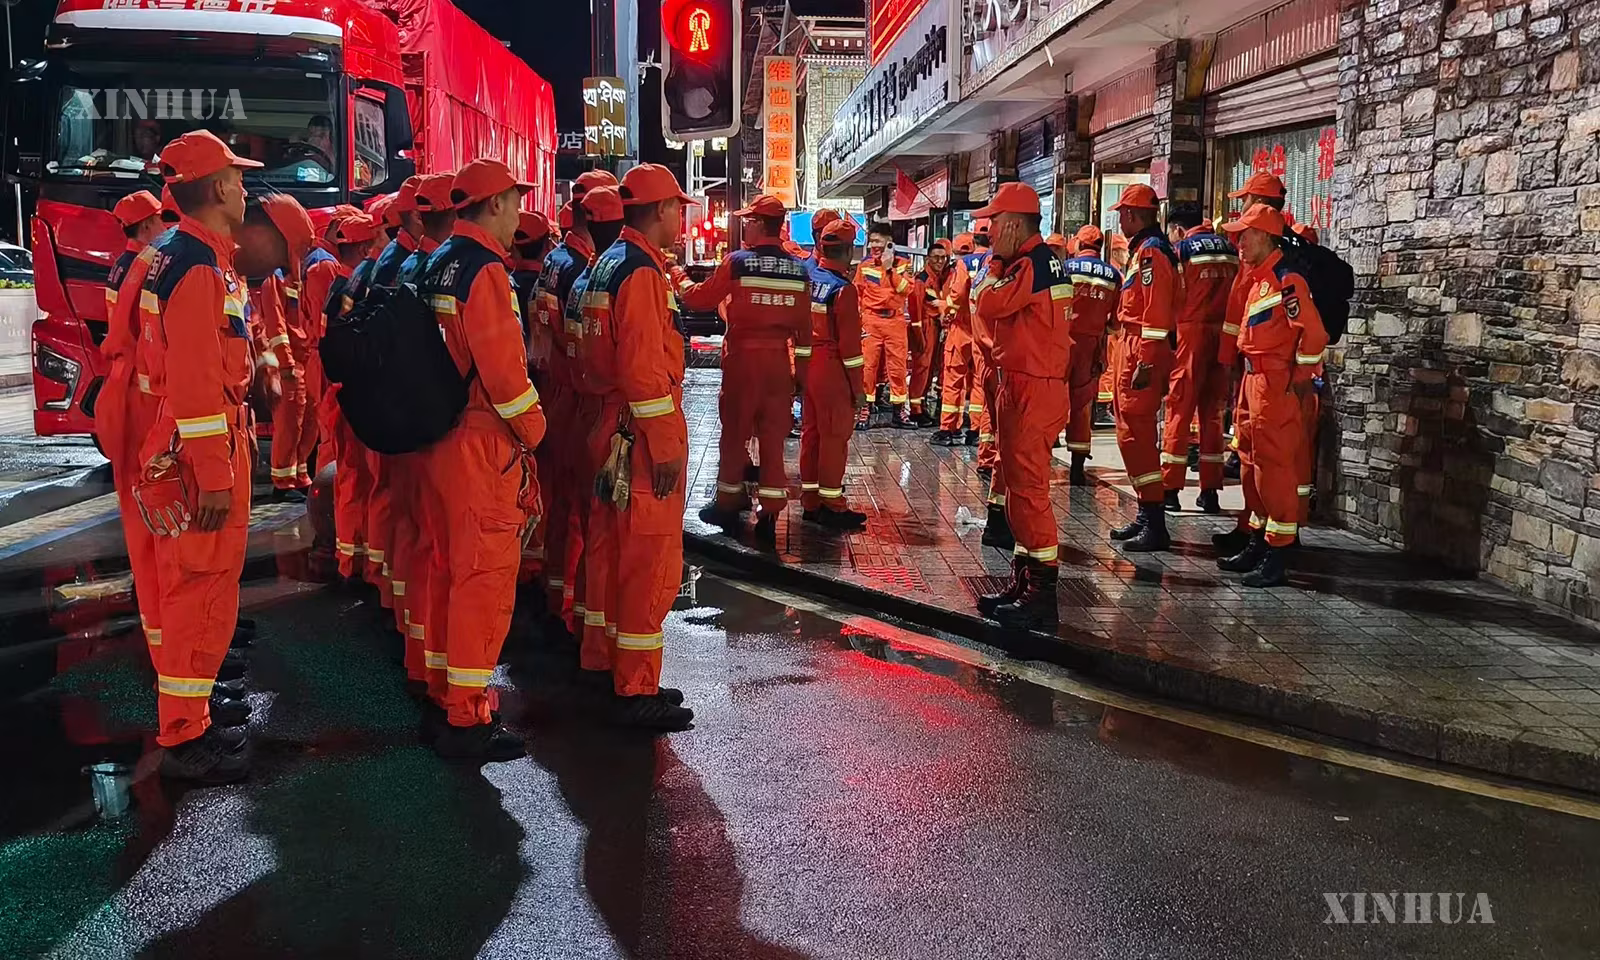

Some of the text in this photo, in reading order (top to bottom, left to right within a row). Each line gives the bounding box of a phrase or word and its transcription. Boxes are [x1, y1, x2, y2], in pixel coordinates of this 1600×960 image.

[767, 59, 792, 189] 维也纳酒店
[556, 131, 585, 150] 店
[744, 255, 803, 276] 中国消防
[1068, 260, 1114, 279] 中国消防
